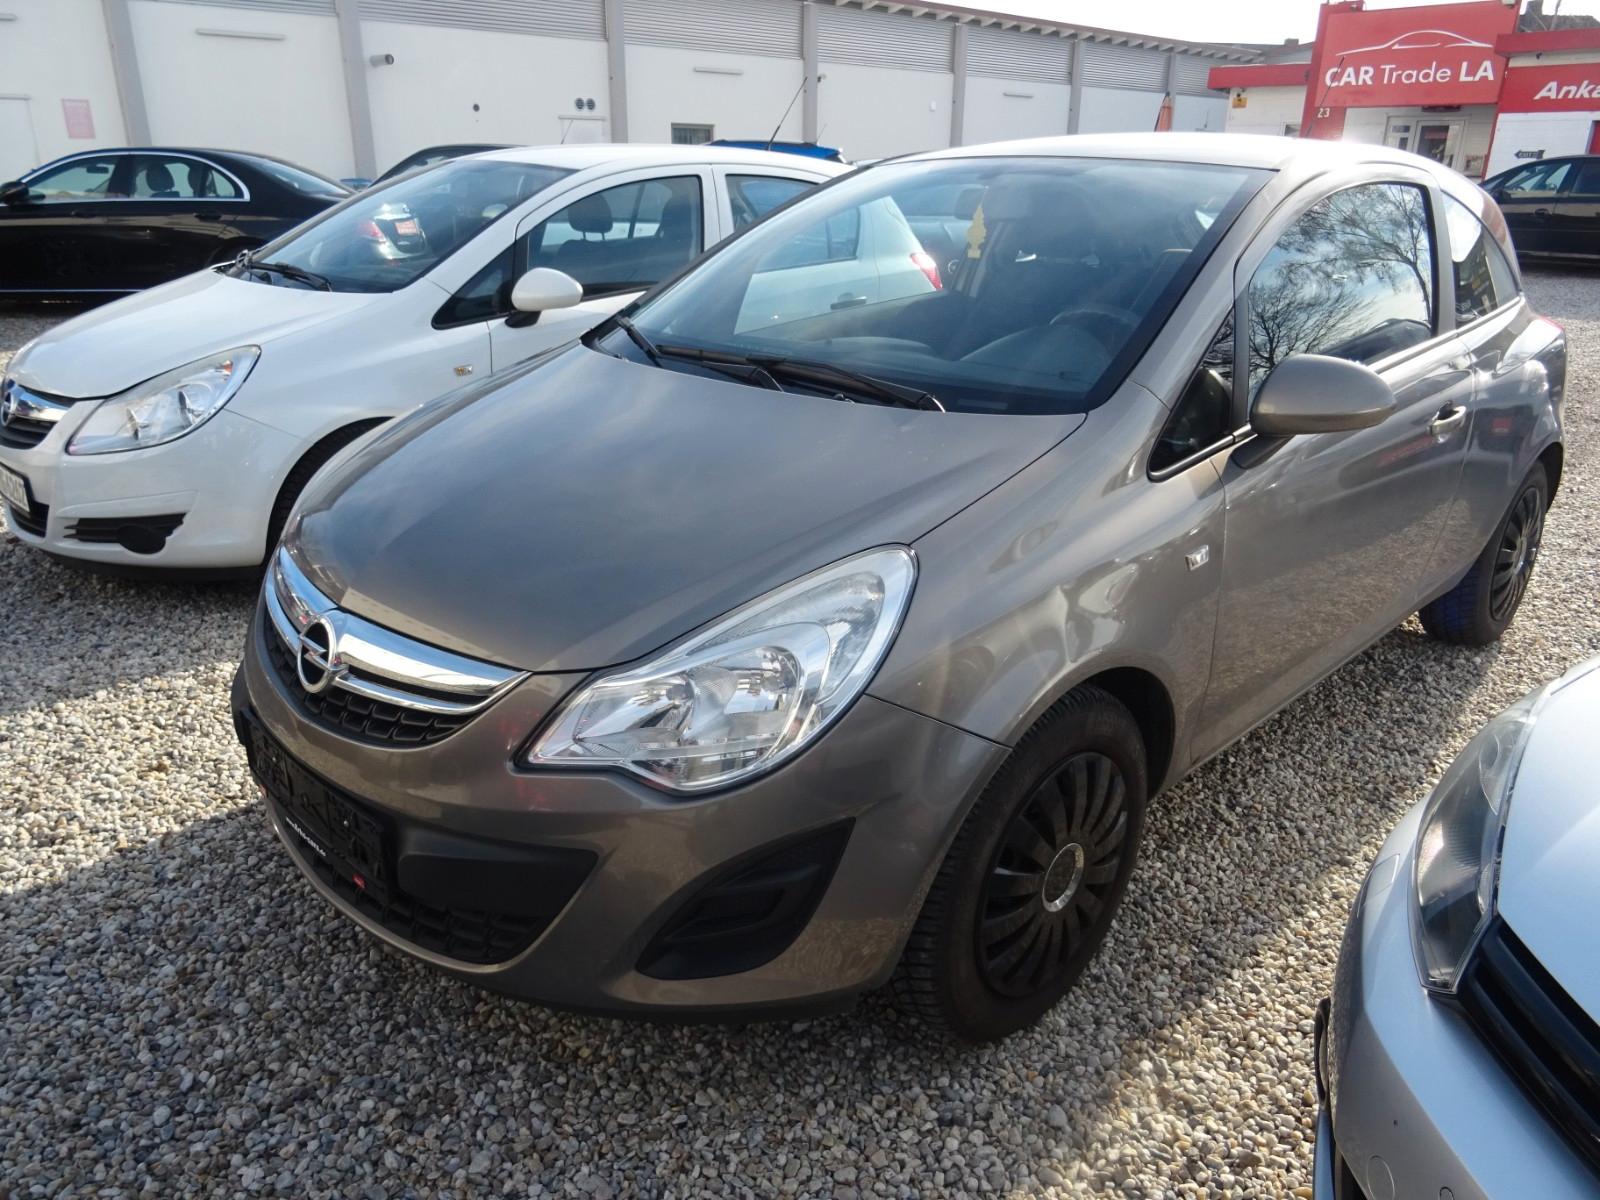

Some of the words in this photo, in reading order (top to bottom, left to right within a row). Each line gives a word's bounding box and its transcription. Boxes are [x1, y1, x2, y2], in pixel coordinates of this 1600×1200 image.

[1324, 66, 1375, 88] CAR
[1380, 61, 1451, 85] Trade
[1458, 60, 1495, 82] LA
[1317, 107, 1330, 118] 23
